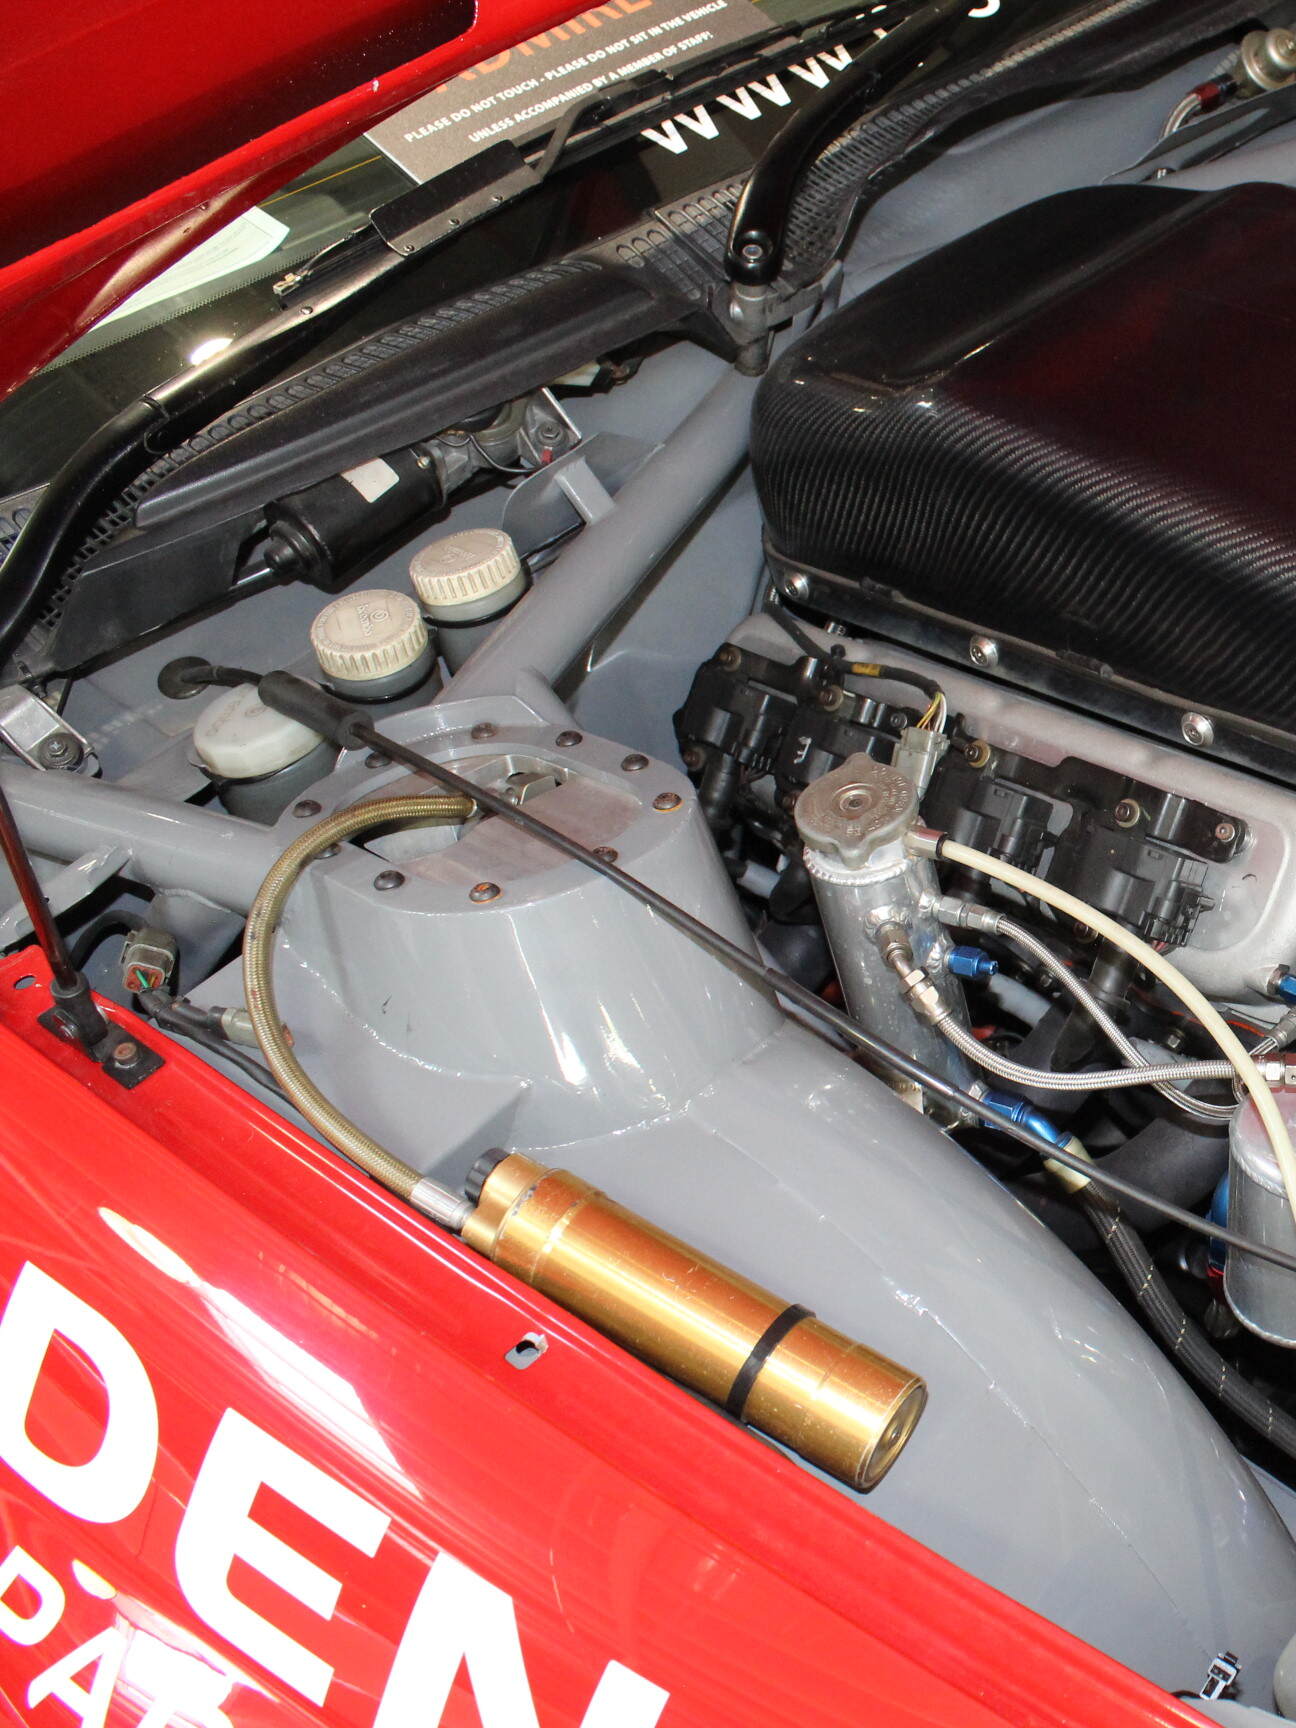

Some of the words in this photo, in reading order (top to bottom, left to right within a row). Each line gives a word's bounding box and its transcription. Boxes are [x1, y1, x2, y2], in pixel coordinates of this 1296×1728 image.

[404, 116, 452, 143] PLEASE
[450, 108, 472, 123] DO
[470, 96, 497, 113] NOT
[496, 78, 539, 101] TOUCH
[544, 56, 589, 81] PLEASE
[586, 49, 607, 63] DO
[605, 37, 631, 54] NOT
[630, 31, 649, 45] SIT
[647, 24, 664, 38] IN
[660, 16, 685, 32] THE
[682, 0, 728, 22] VEHICLE
[468, 117, 515, 143] UNLESS
[514, 82, 594, 123] ACCOMPANIED
[592, 75, 609, 88] BY
[608, 71, 619, 81] A
[617, 52, 665, 76] MEMBER
[662, 45, 679, 57] OF
[677, 31, 714, 52] STAFF!
